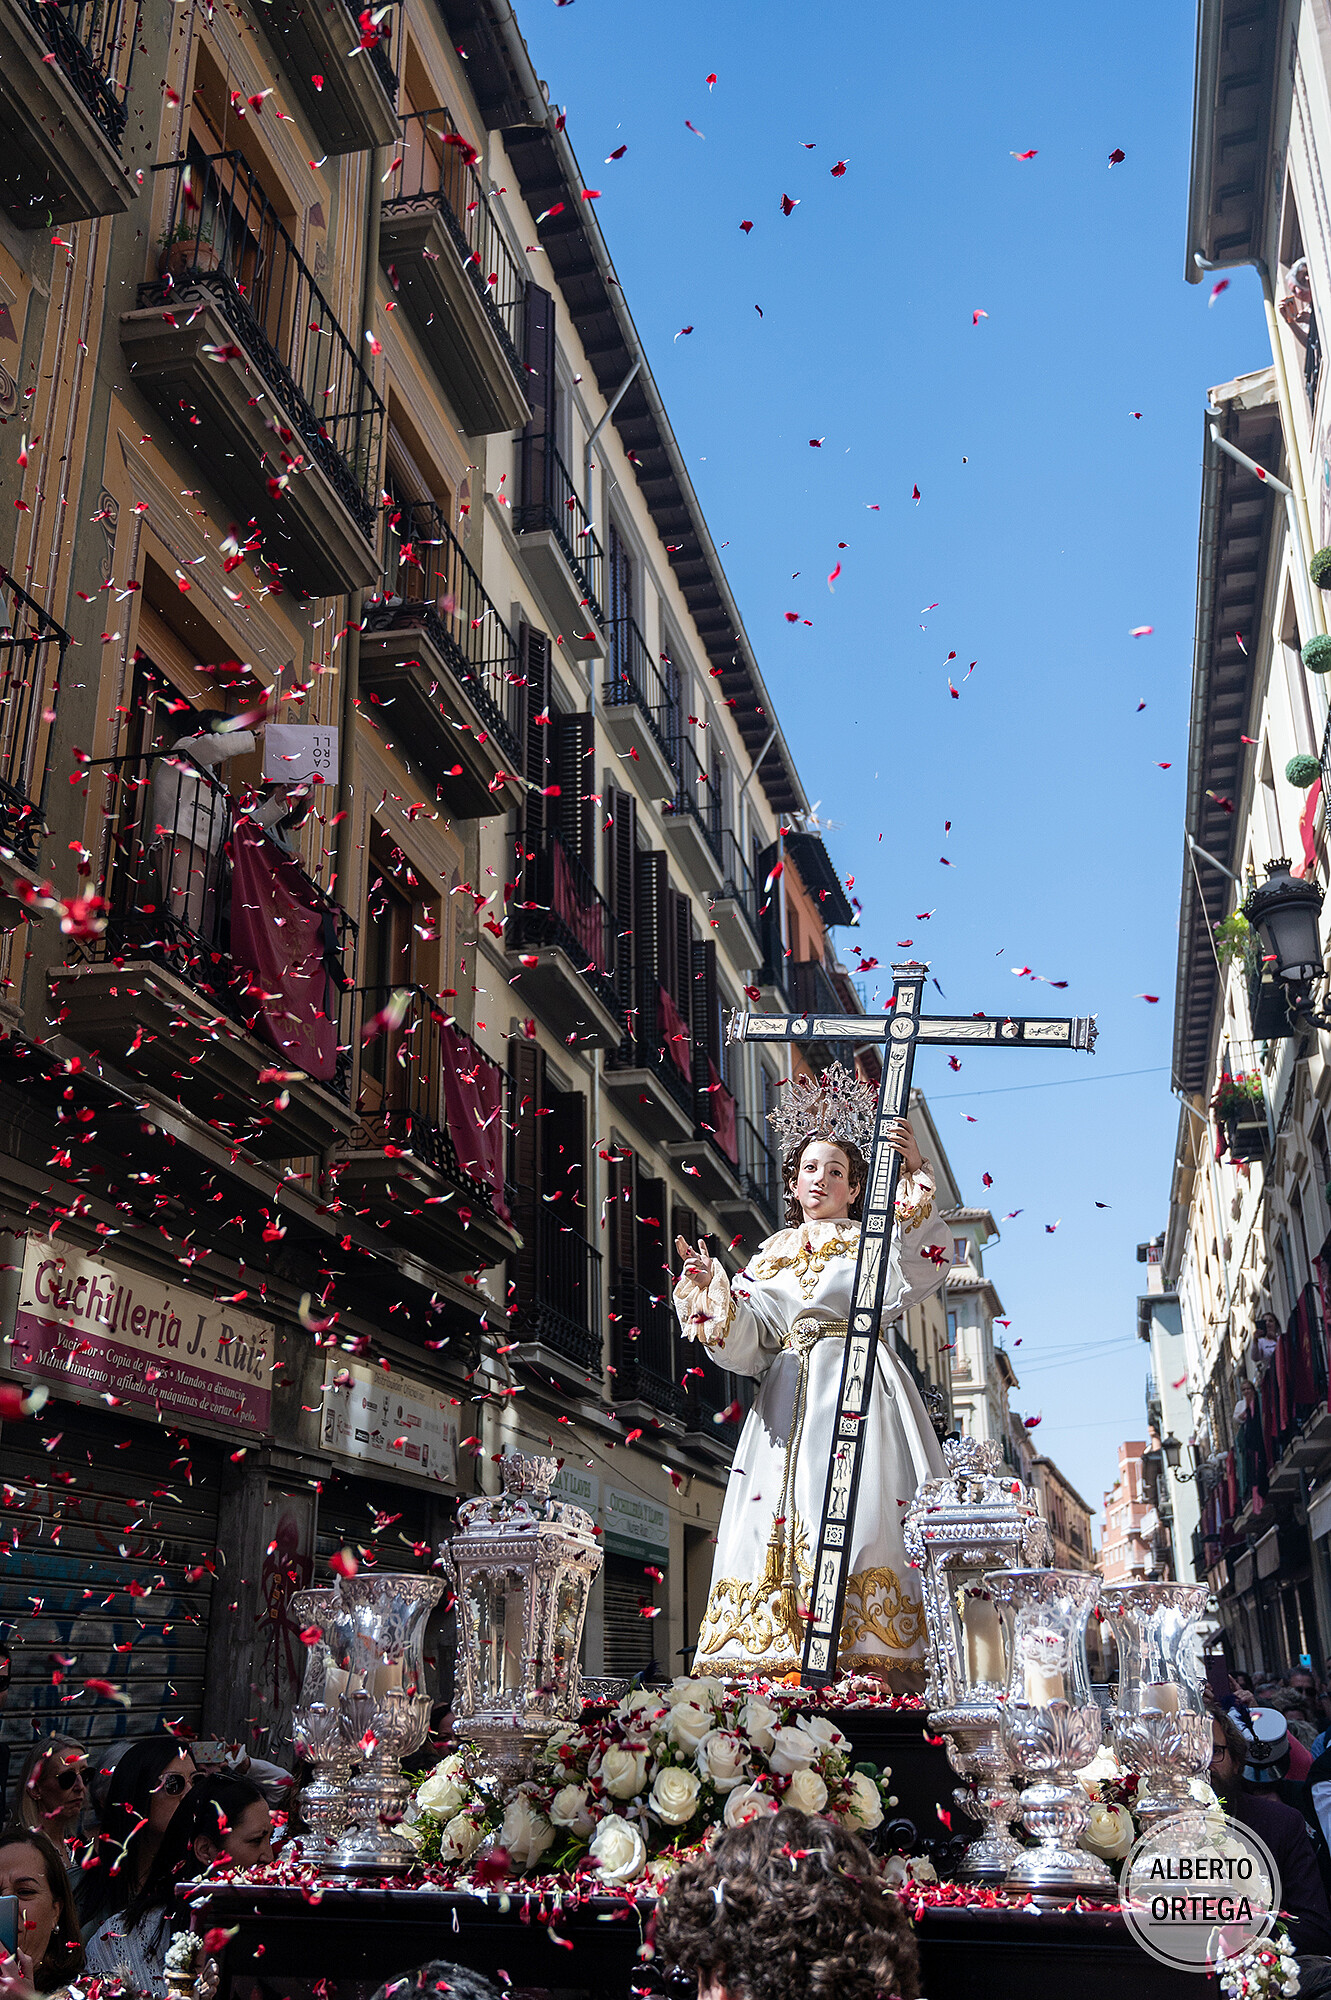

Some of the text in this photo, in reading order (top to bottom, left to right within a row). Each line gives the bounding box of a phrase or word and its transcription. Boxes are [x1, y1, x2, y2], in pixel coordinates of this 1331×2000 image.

[34, 1258, 264, 1381] Cuchillería J. Ruiz
[105, 1348, 131, 1369] Copia
[132, 1357, 144, 1372] de
[175, 1369, 206, 1390] Mandos
[207, 1382, 214, 1392] a
[108, 1374, 116, 1387] y
[116, 1372, 147, 1393] afilado
[147, 1382, 159, 1397] de
[158, 1387, 198, 1407] máquinas
[199, 1396, 209, 1411] de
[209, 1402, 233, 1417] cortar
